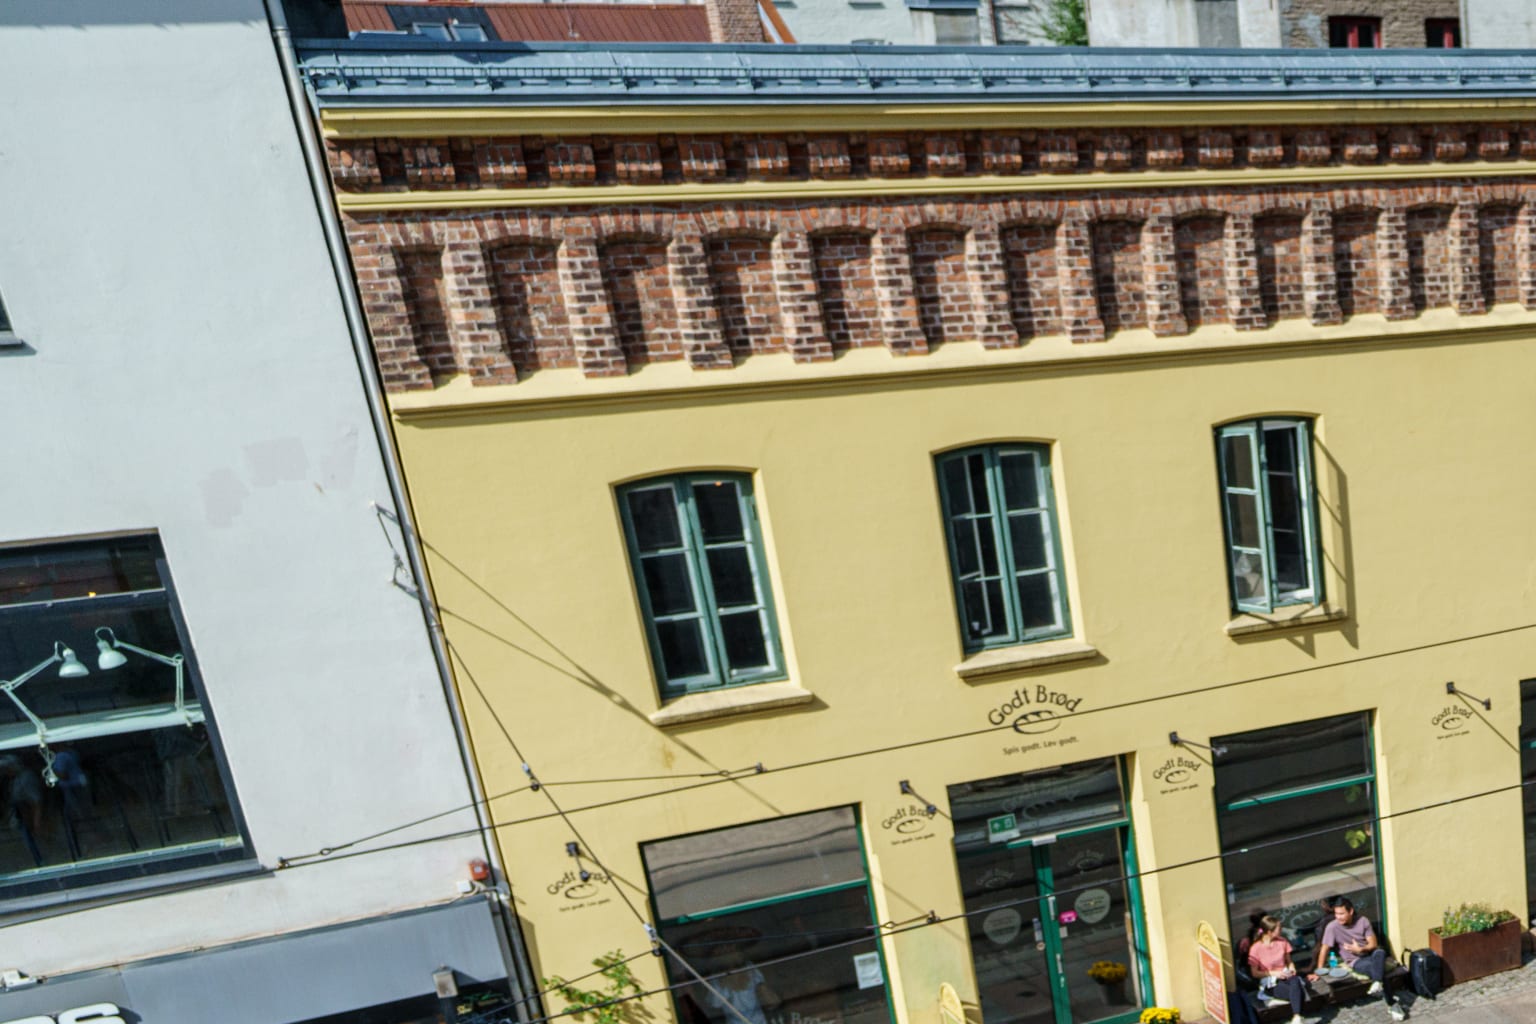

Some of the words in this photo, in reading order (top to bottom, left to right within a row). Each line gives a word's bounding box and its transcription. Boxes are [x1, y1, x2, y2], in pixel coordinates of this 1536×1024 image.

[988, 687, 1031, 726] Godt
[1036, 684, 1083, 713] Brød
[1153, 758, 1175, 779] Godt
[882, 808, 907, 829] Godt
[547, 871, 576, 895] Godt
